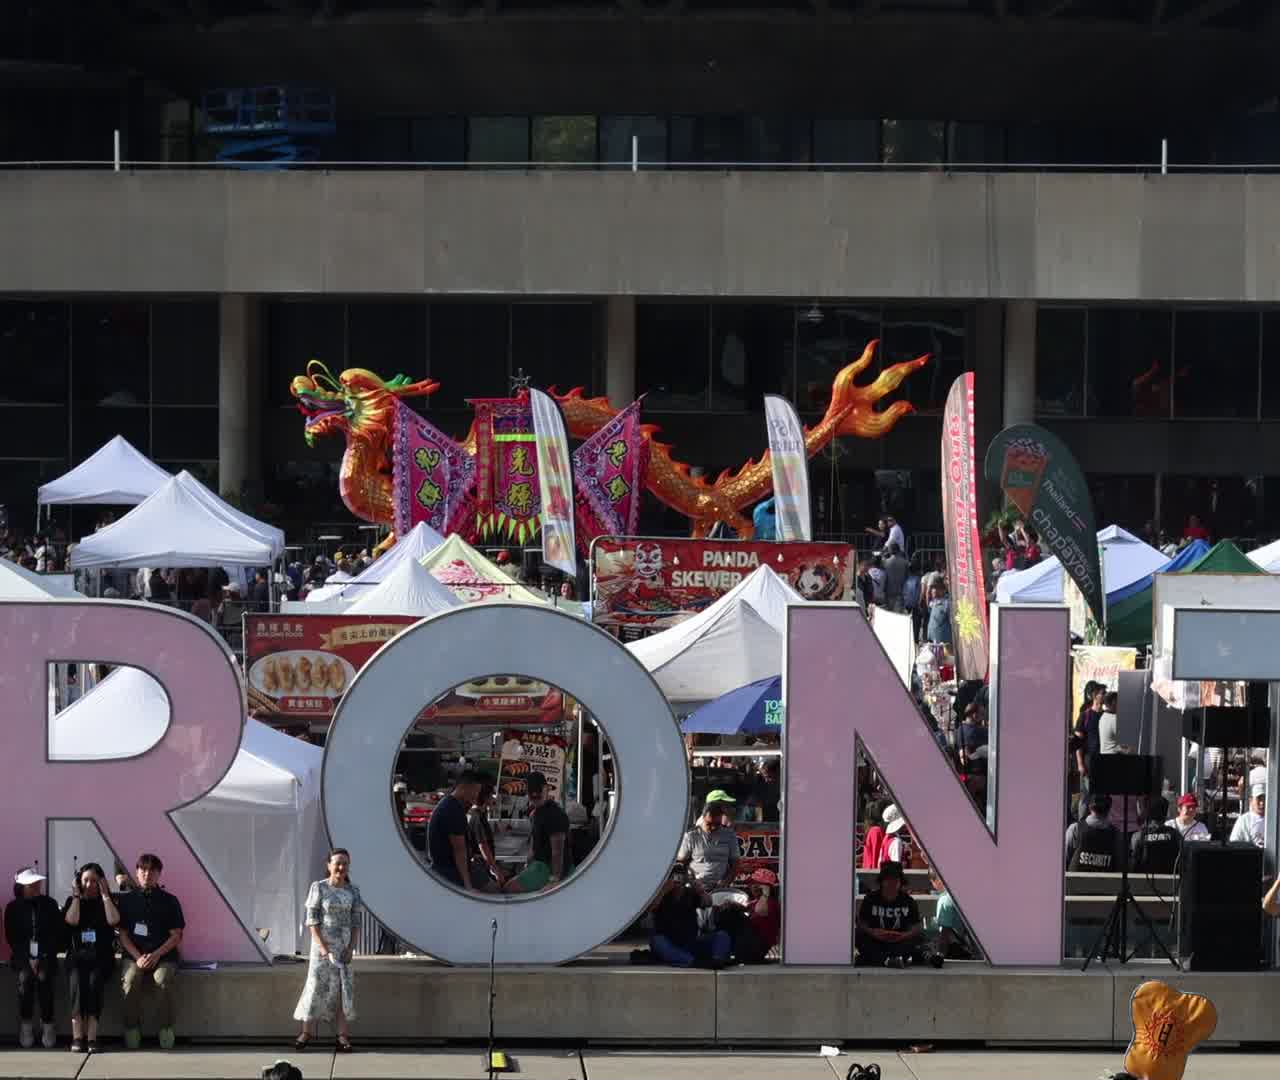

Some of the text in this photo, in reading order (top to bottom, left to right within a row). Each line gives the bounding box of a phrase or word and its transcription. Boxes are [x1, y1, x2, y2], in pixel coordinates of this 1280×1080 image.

[1042, 479, 1075, 519] Thailand
[703, 551, 760, 567] PANDA
[1032, 507, 1096, 594] chapayom
[672, 571, 742, 588] SKEWER
[1079, 851, 1113, 868] SECURITY
